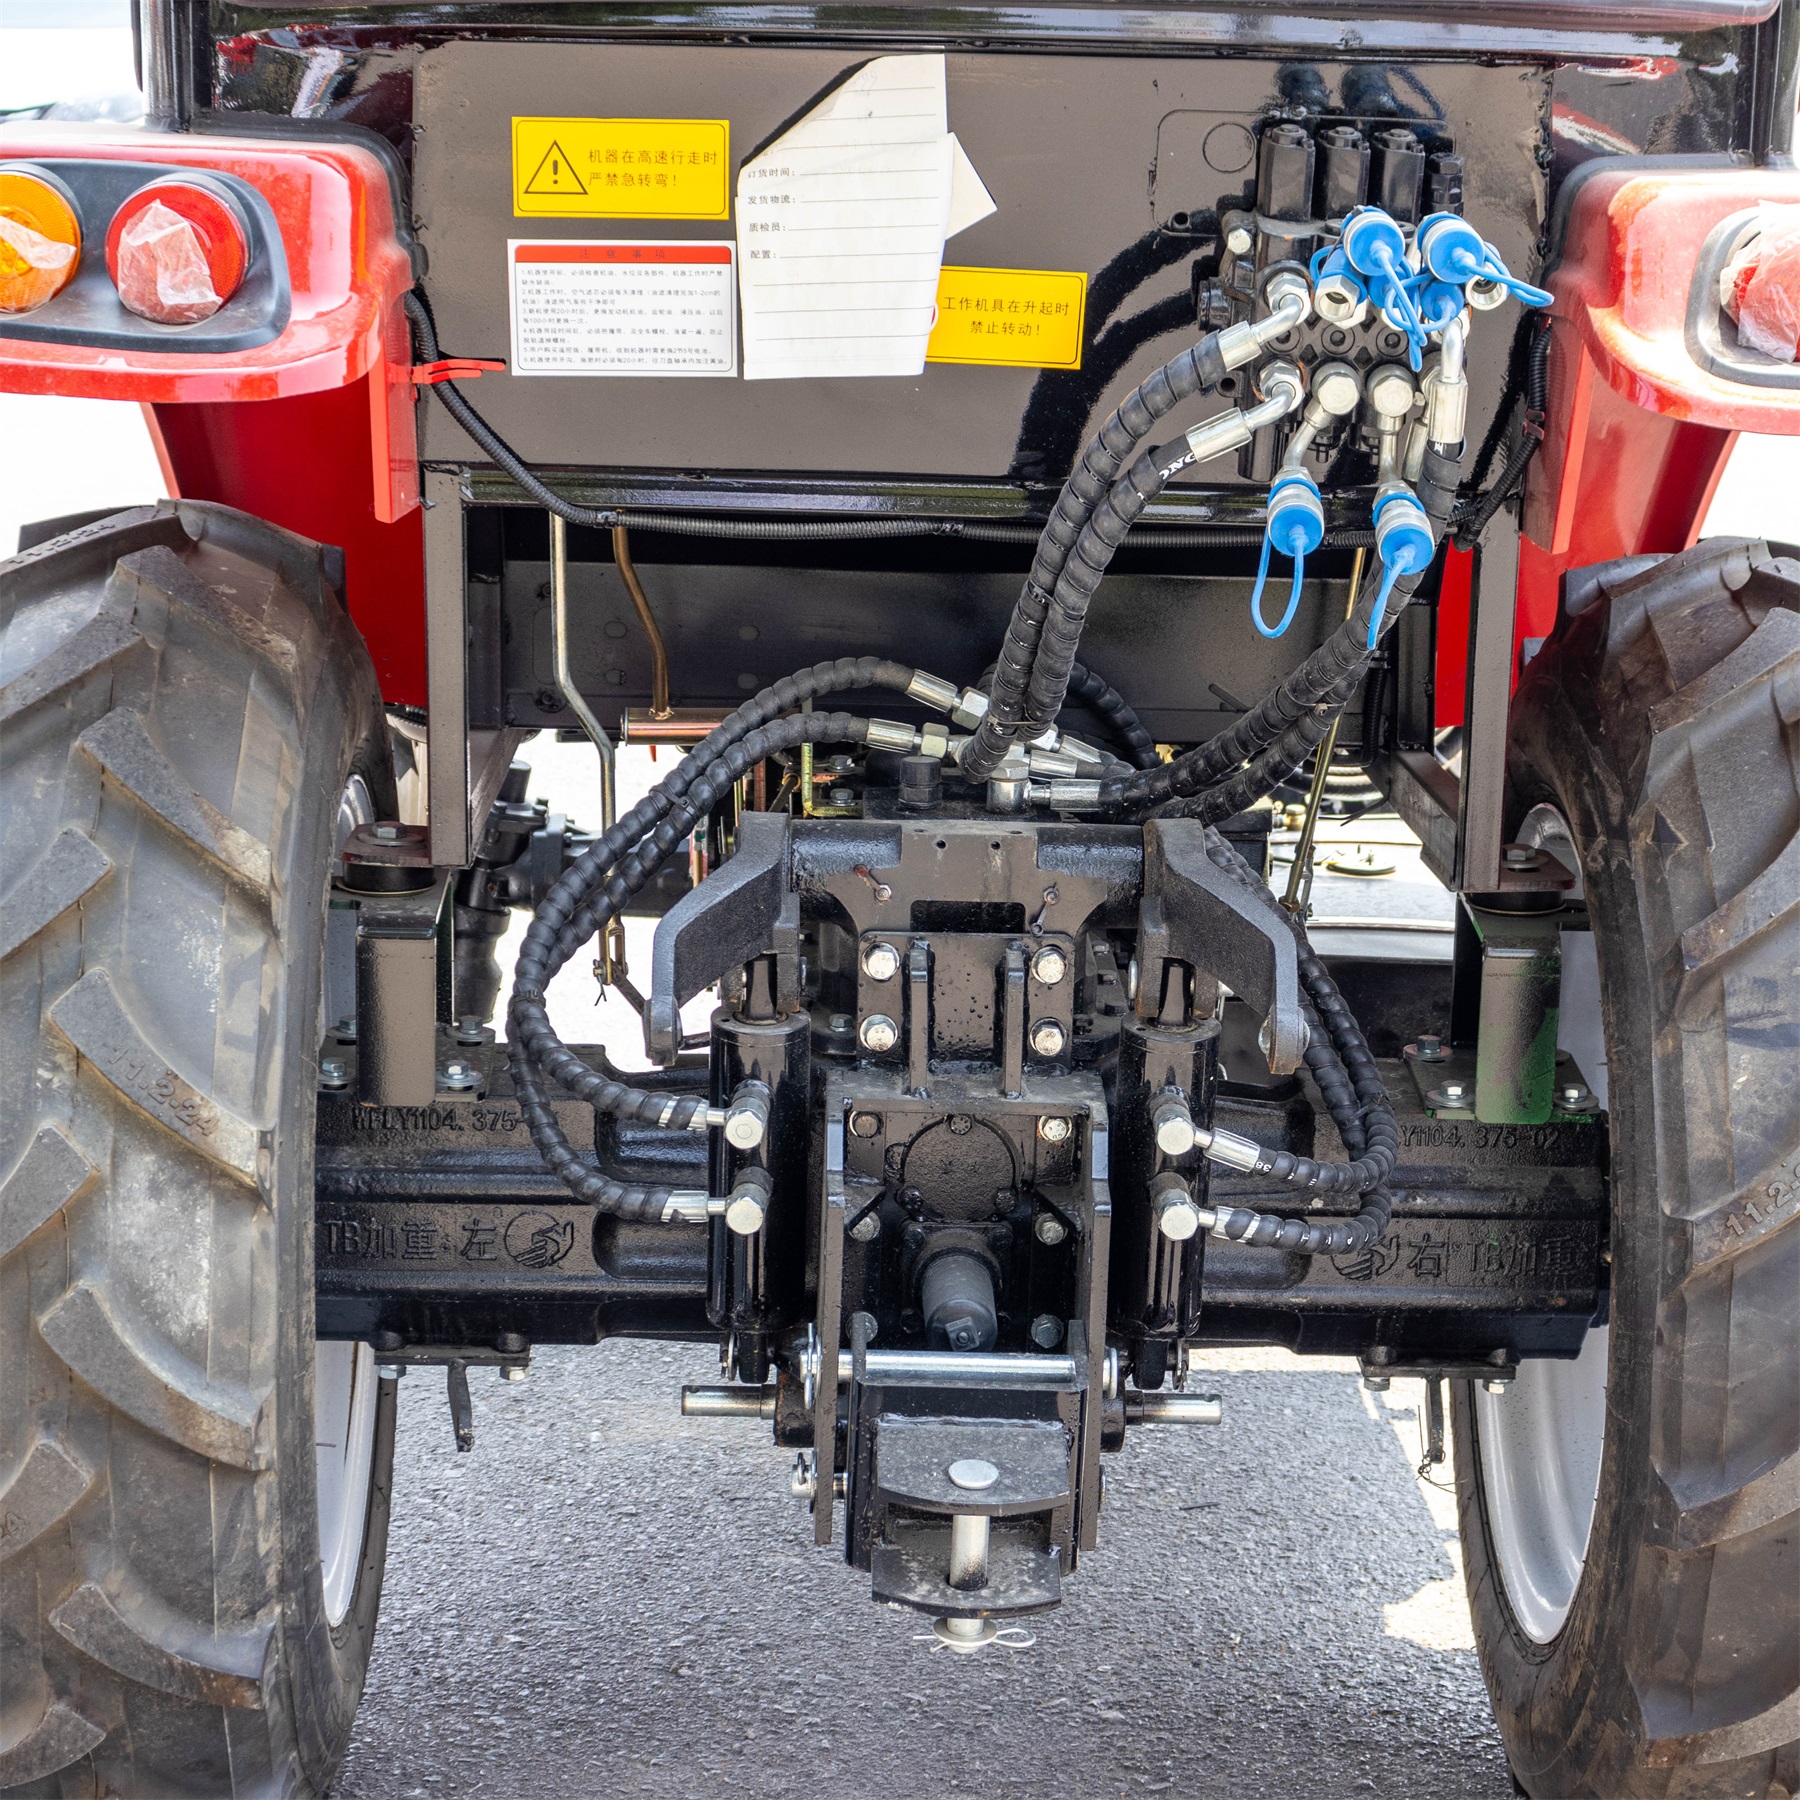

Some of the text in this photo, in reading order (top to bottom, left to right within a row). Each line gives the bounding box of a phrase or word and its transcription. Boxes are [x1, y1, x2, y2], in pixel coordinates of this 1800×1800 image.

[588, 149, 718, 165] 机器在高速行走时
[588, 172, 678, 187] 严禁急转弯！
[942, 296, 1069, 316] 工作机具在升起时
[970, 320, 1040, 336] 禁止转动！
[1408, 1233, 1447, 1278] 右
